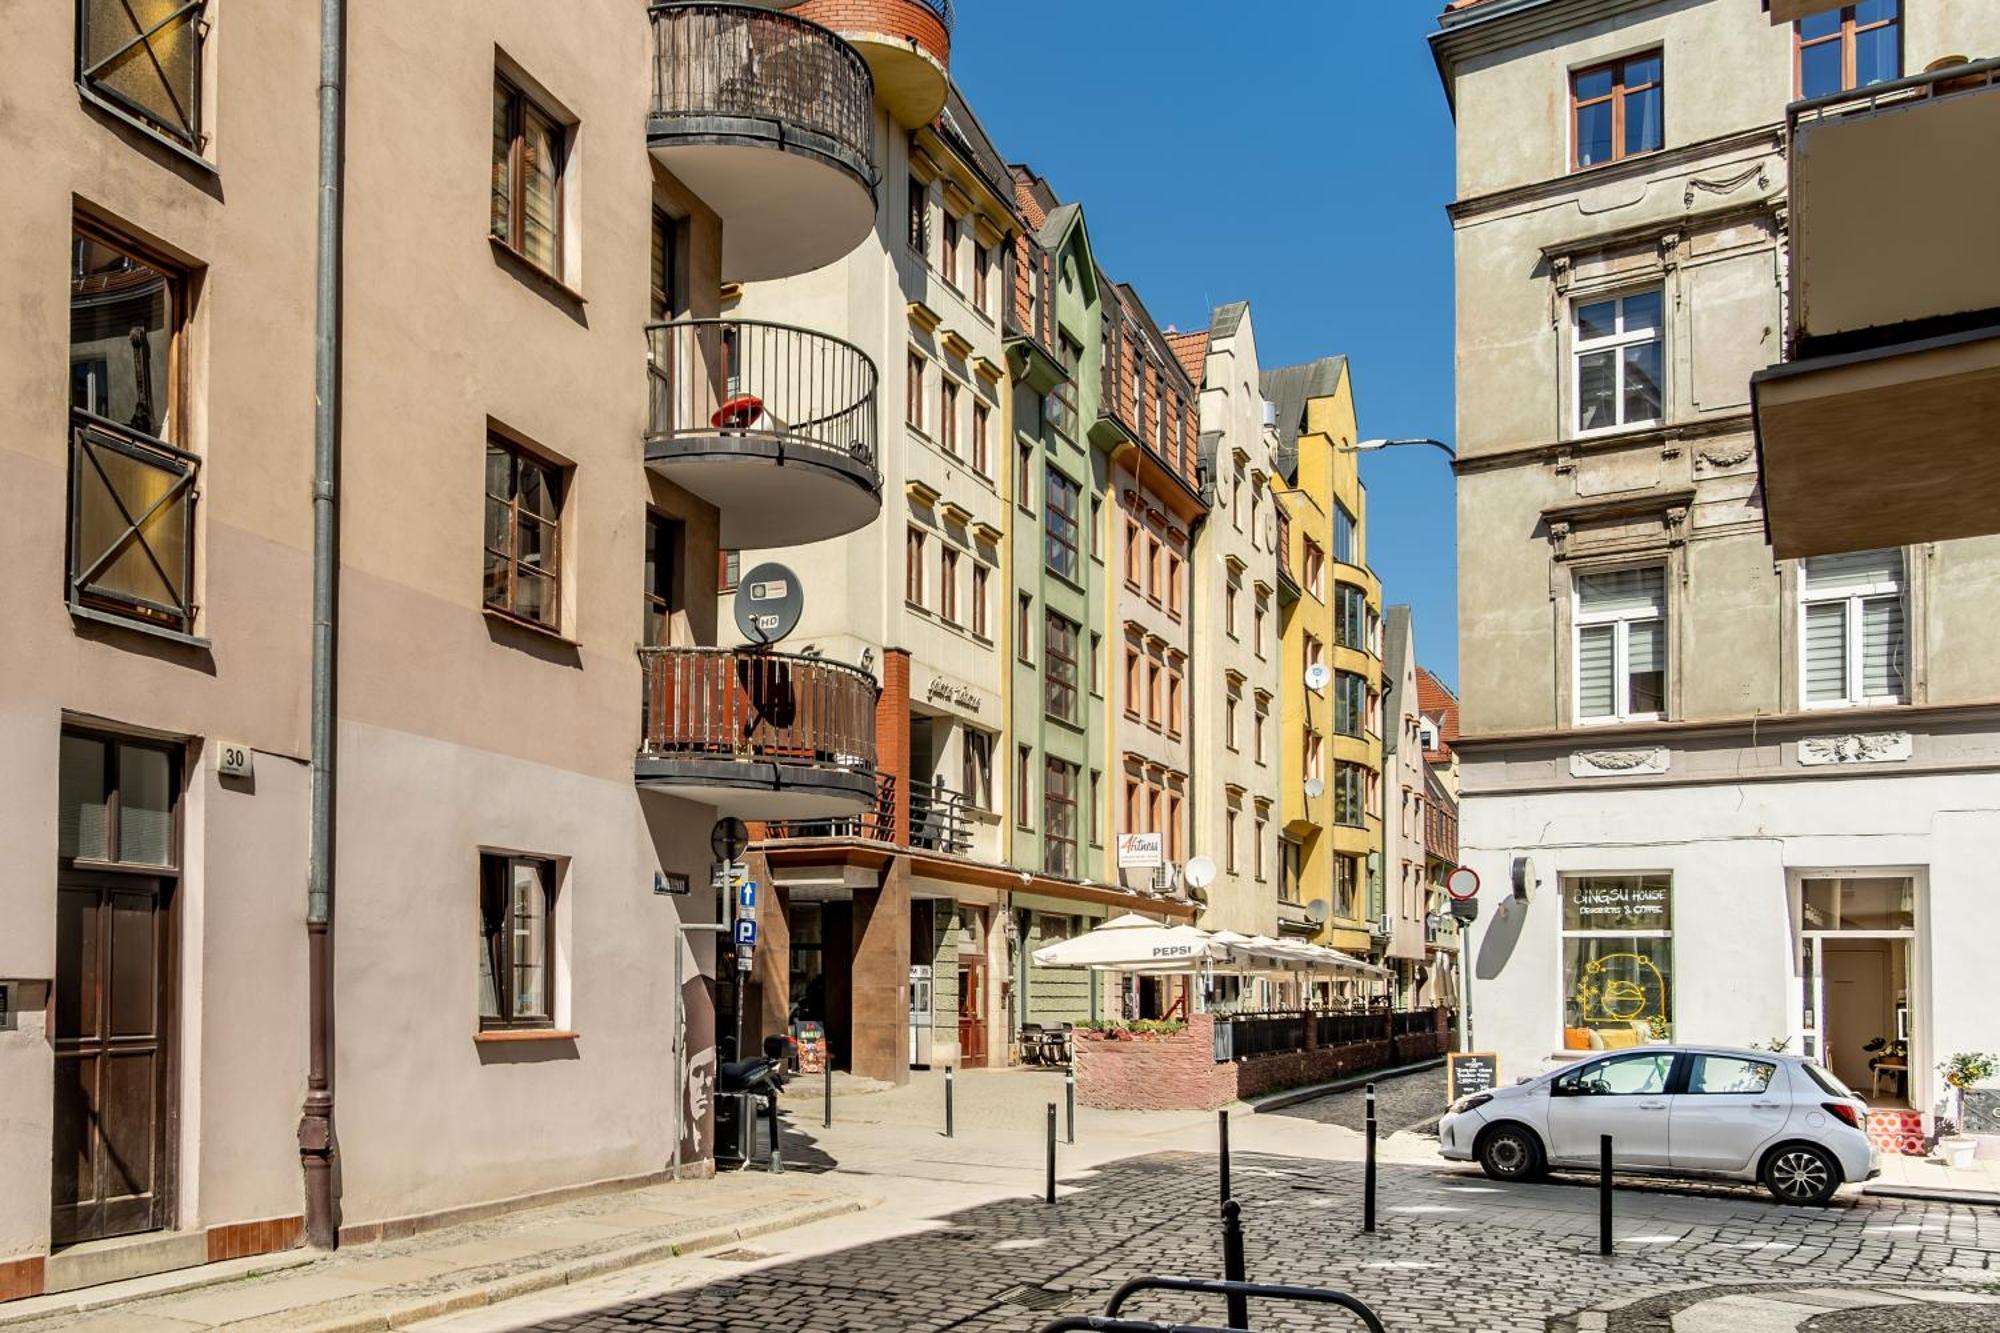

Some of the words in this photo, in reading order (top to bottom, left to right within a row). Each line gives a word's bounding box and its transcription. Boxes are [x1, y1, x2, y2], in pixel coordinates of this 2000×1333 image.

[760, 616, 778, 628] HD
[226, 748, 244, 767] 30
[1573, 888, 1629, 905] BINGSU
[1632, 889, 1667, 902] HOUSE
[1623, 904, 1632, 914] &
[1633, 904, 1664, 914] COFFEE
[739, 922, 753, 942] P
[1152, 945, 1192, 957] PEPSI
